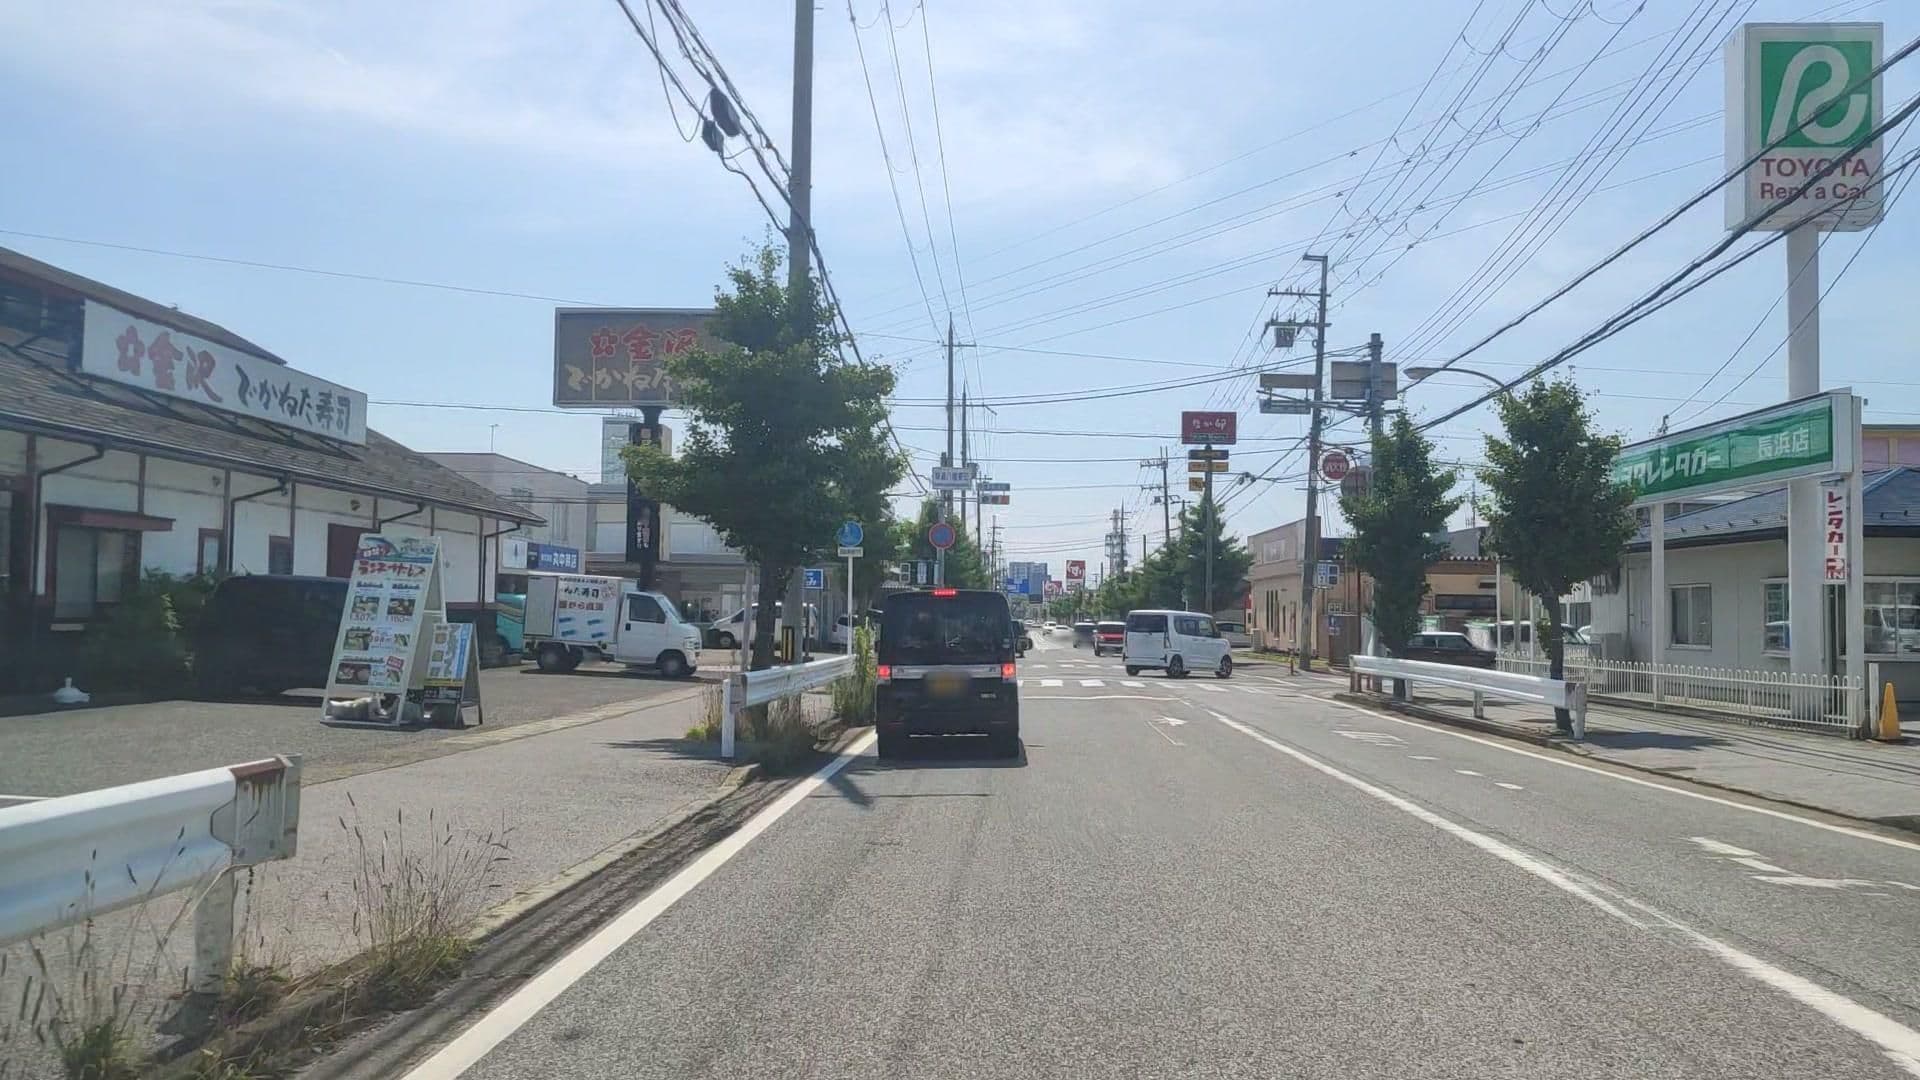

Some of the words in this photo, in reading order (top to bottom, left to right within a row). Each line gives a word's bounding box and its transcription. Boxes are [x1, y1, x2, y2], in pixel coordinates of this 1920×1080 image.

[1761, 158, 1870, 177] TOYOTA
[1760, 182, 1809, 200] Rent
[1814, 186, 1826, 200] a
[1832, 182, 1869, 200] Car
[1610, 446, 1721, 489] ヨタレンタカー
[1757, 427, 1810, 459] 長浜店
[1827, 491, 1844, 556] レンタカー
